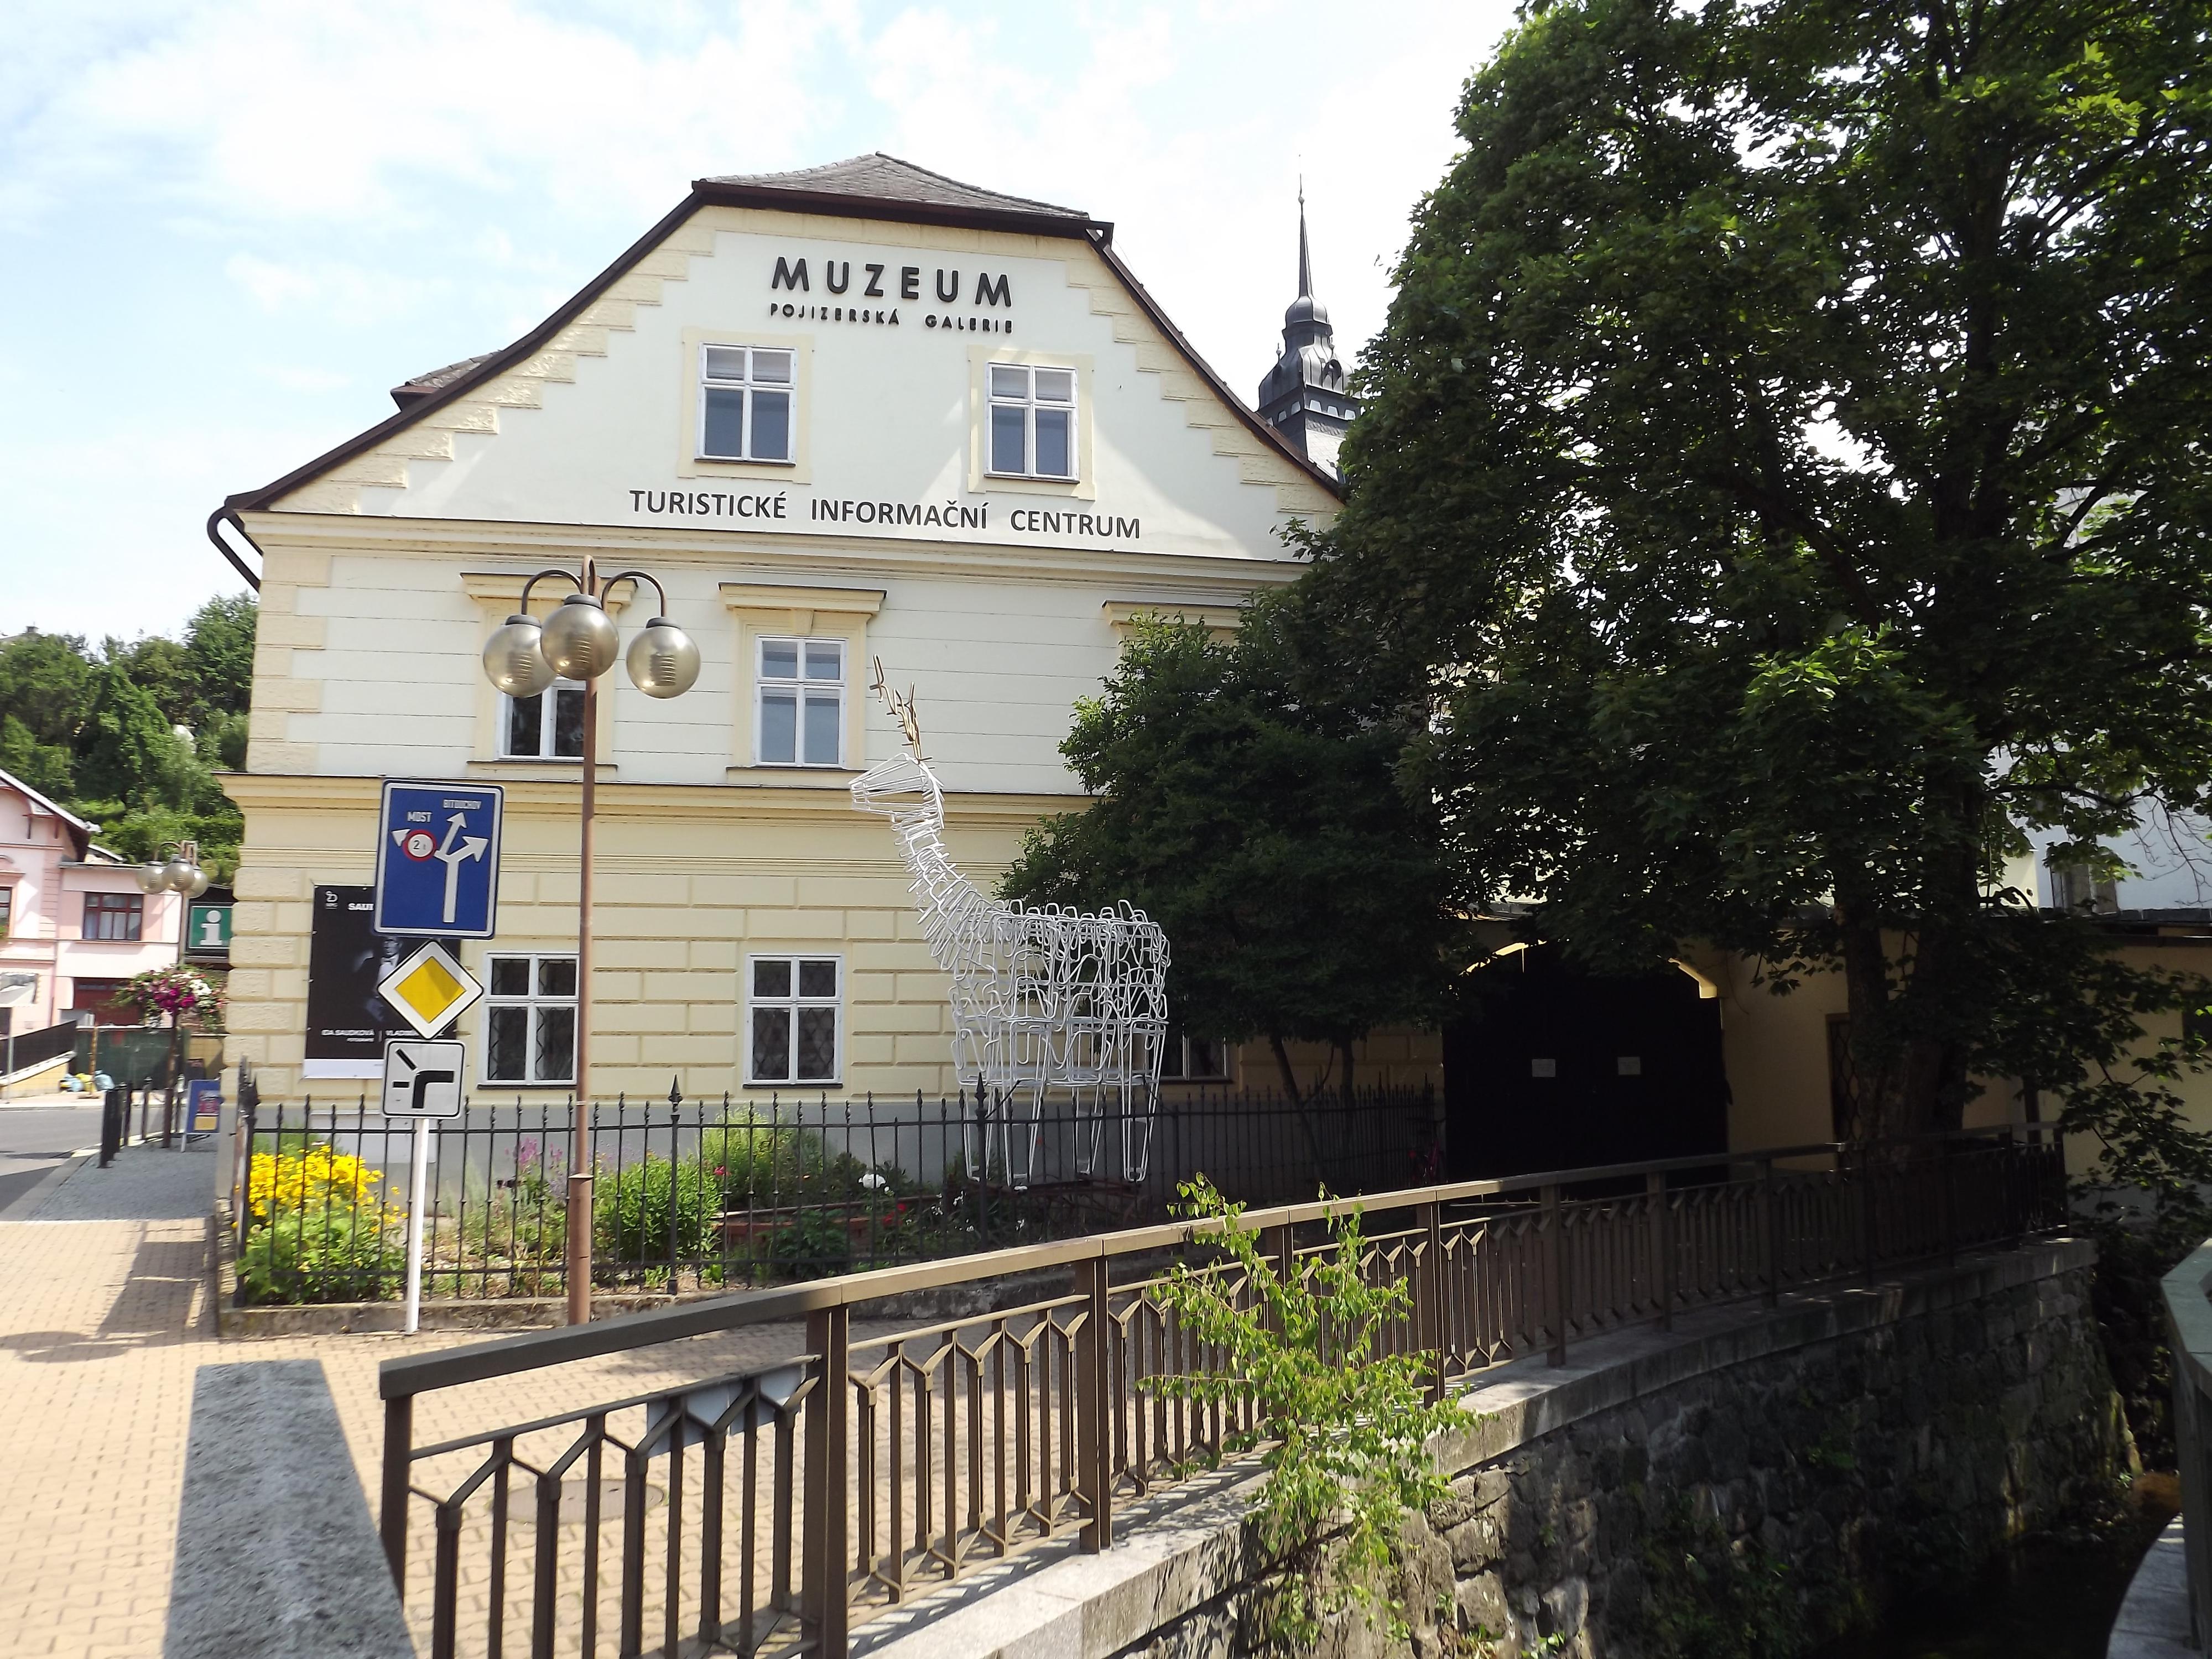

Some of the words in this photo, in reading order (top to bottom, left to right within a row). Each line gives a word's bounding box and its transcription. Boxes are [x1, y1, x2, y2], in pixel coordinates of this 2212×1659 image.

[771, 257, 1012, 307] MUZEUM
[769, 302, 900, 326] POJIZERSKÁ
[925, 314, 1013, 334] GALERIE
[628, 489, 787, 519] TURISTICKÉ
[811, 498, 988, 530] INFORMAČNÍ
[1011, 508, 1140, 540] CENTRUM
[407, 811, 433, 822] MOST
[413, 839, 420, 850] 2
